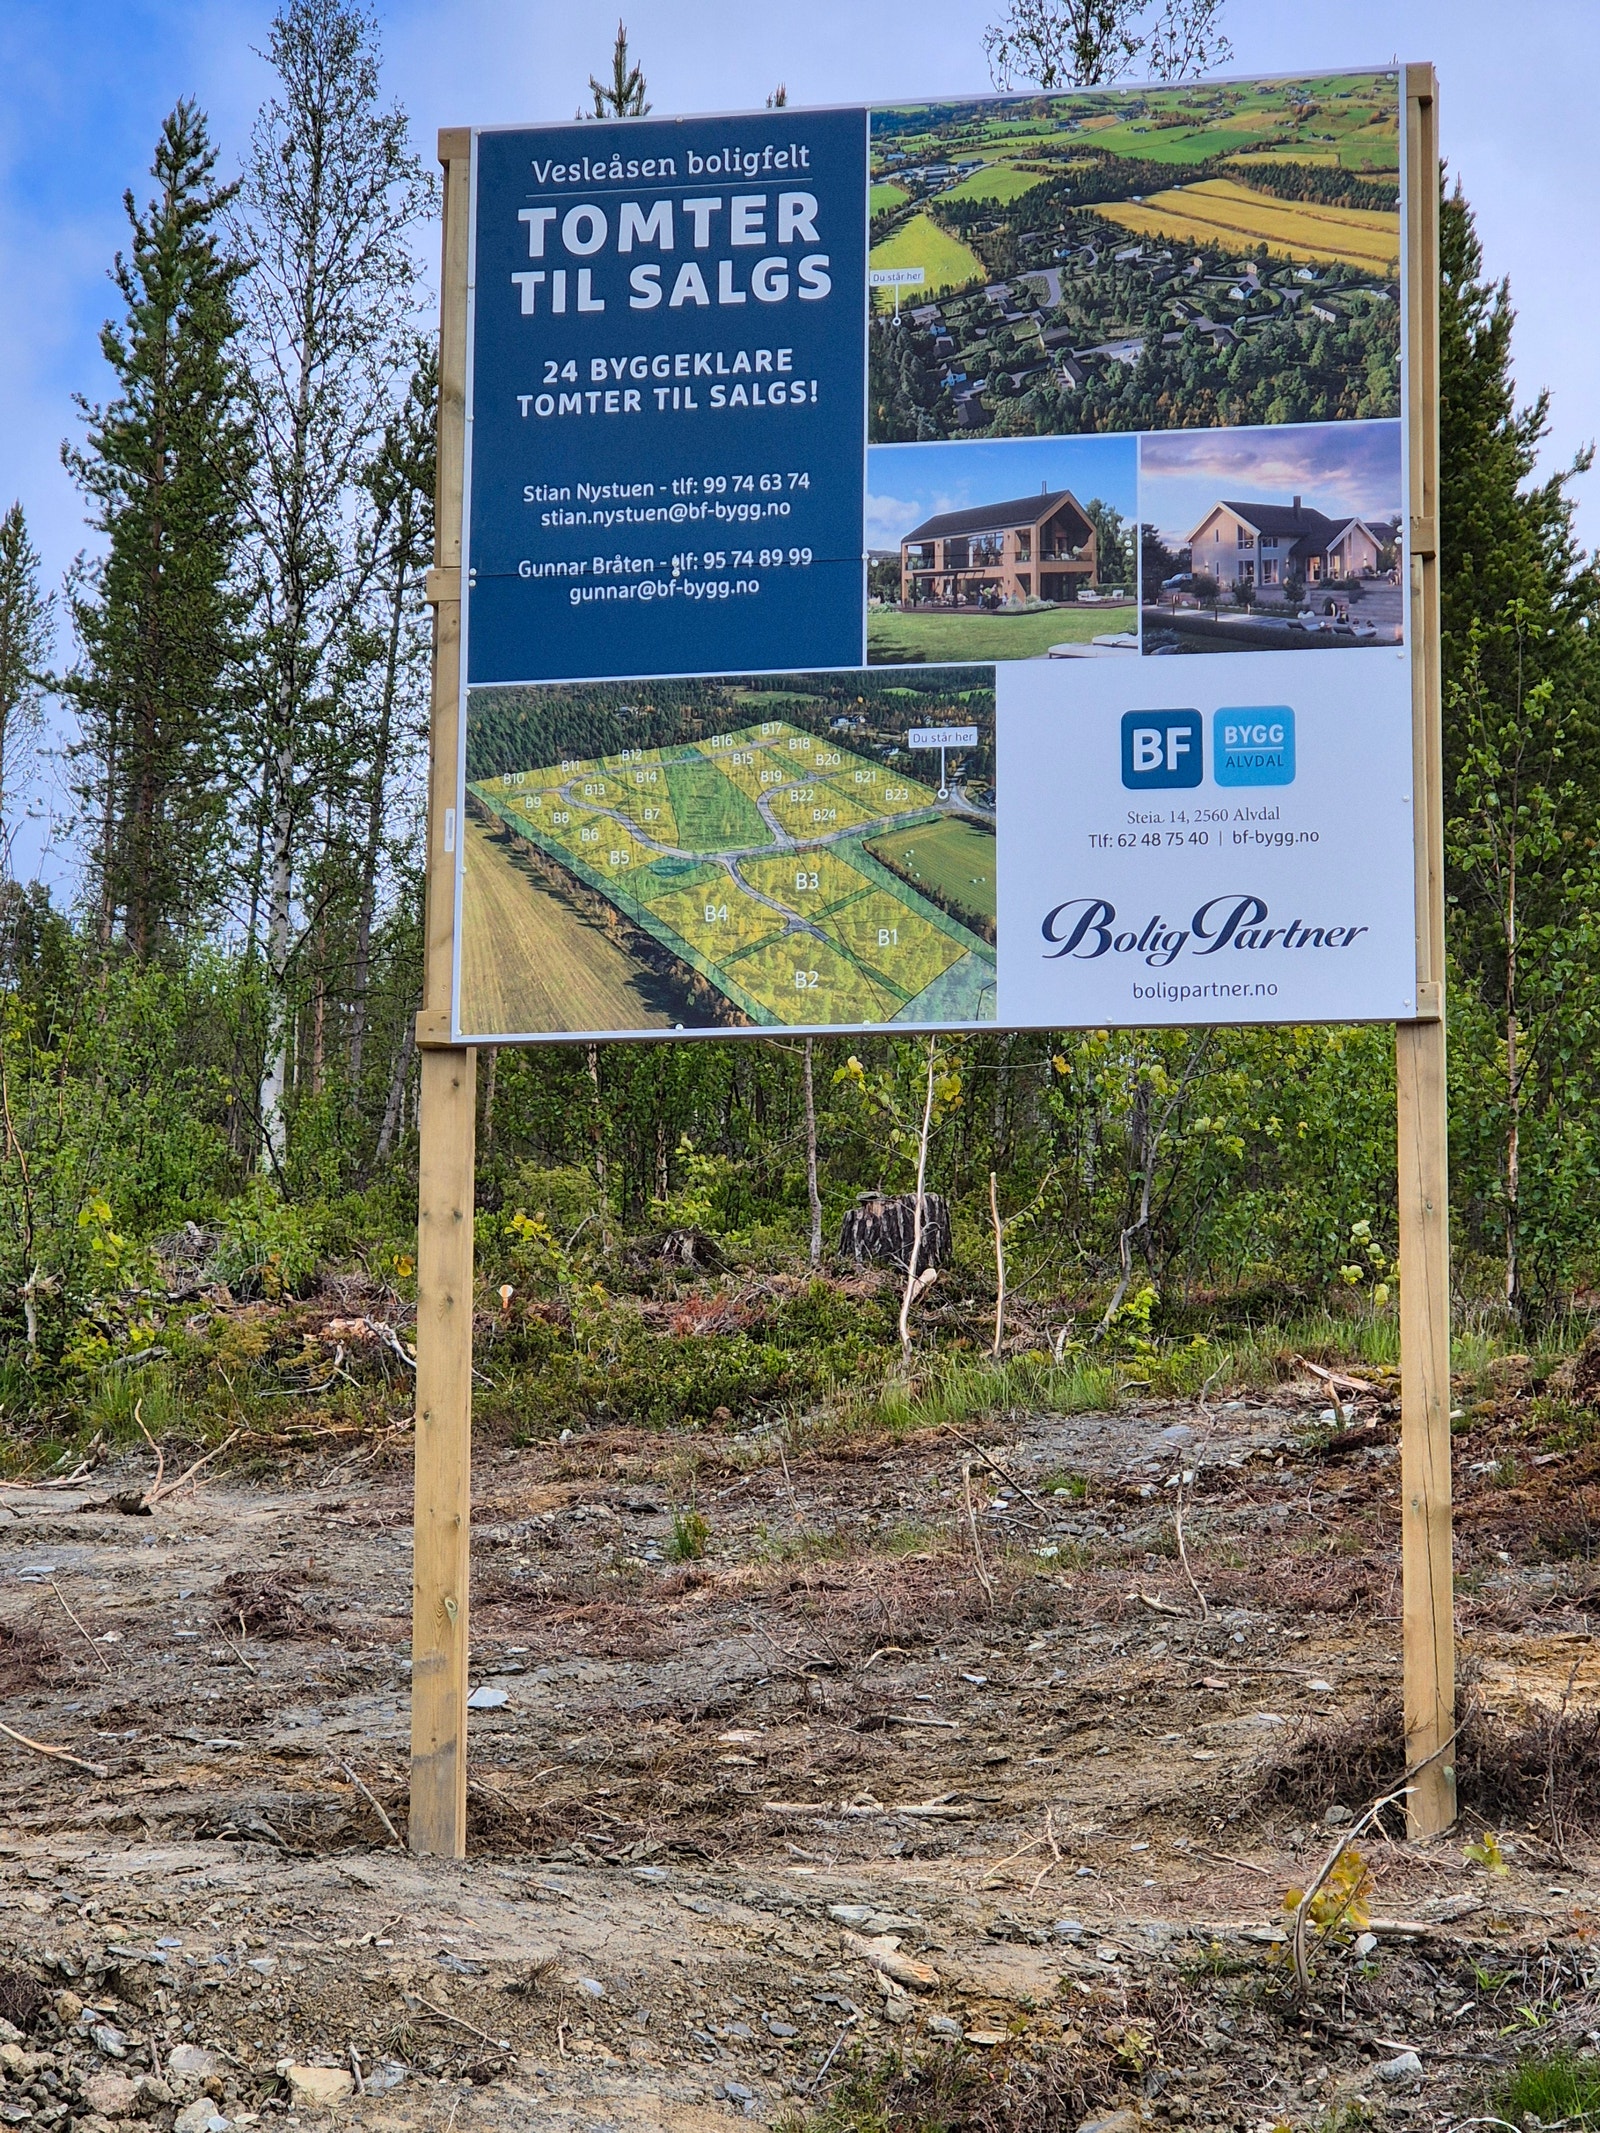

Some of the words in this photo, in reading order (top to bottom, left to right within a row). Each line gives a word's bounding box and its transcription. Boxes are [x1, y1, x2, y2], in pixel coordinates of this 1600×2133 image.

[532, 154, 677, 184] Vesleåsen
[687, 144, 810, 178] boligfelt
[518, 191, 821, 257] TOMTER
[888, 272, 903, 280] står
[907, 272, 921, 280] her
[511, 268, 604, 314] TIL
[629, 254, 831, 309] SALGS
[543, 360, 577, 383] 24
[591, 348, 793, 381] BYGGEKLARE
[517, 388, 641, 417] TOMTER
[653, 385, 698, 410] TIL
[710, 380, 818, 407] SALGS!
[523, 485, 570, 502] Stian
[577, 482, 654, 502] Nystuen
[672, 478, 698, 495] tlf:
[703, 477, 726, 493] 99
[732, 475, 754, 492] 74
[759, 474, 782, 490] 63
[787, 473, 810, 489] 74
[541, 501, 791, 527] stian.nystuen@bf-bygg.no
[518, 558, 587, 577] Gunnar
[593, 555, 654, 574] Bråten
[703, 552, 726, 569] 95
[731, 551, 753, 568] 74
[759, 549, 783, 566] 89
[789, 548, 813, 565] 99
[570, 579, 759, 605] gunnar@bf-bygg.no
[761, 723, 782, 734] B17
[1225, 724, 1284, 744] BYGG
[712, 736, 732, 747] B16
[789, 738, 810, 749] B18
[913, 733, 928, 744] Du
[931, 731, 953, 742] står
[956, 731, 973, 742] her
[621, 750, 642, 760] B12
[1133, 727, 1192, 771] BF
[733, 753, 753, 764] B15
[816, 754, 841, 766] B20
[1226, 754, 1284, 768] ALVDAL
[562, 761, 580, 771] B11
[503, 773, 524, 784] B10
[636, 772, 657, 783] B14
[760, 770, 782, 782] B19
[855, 771, 876, 783] B21
[585, 785, 605, 795] B13
[791, 790, 814, 802] B22
[885, 789, 908, 800] B23
[526, 797, 541, 808] B9
[553, 813, 569, 824] B8
[644, 809, 659, 819] B7
[813, 809, 836, 821] B24
[1170, 810, 1190, 825] 14,
[1194, 809, 1228, 822] 2560
[1234, 807, 1280, 821] Alvdal
[581, 829, 599, 841] B6
[1088, 834, 1113, 848] Tlf:
[1118, 834, 1136, 847] 62
[1141, 833, 1161, 846] 48
[1166, 832, 1184, 845] 75
[1188, 832, 1209, 845] 40
[1232, 830, 1319, 846] bf-bygg.no
[610, 851, 629, 865] B5
[796, 873, 818, 889] B3
[705, 905, 728, 921] B4
[878, 929, 898, 945] B1
[795, 971, 819, 988] B2
[1133, 981, 1278, 1002] boligpartner.no
